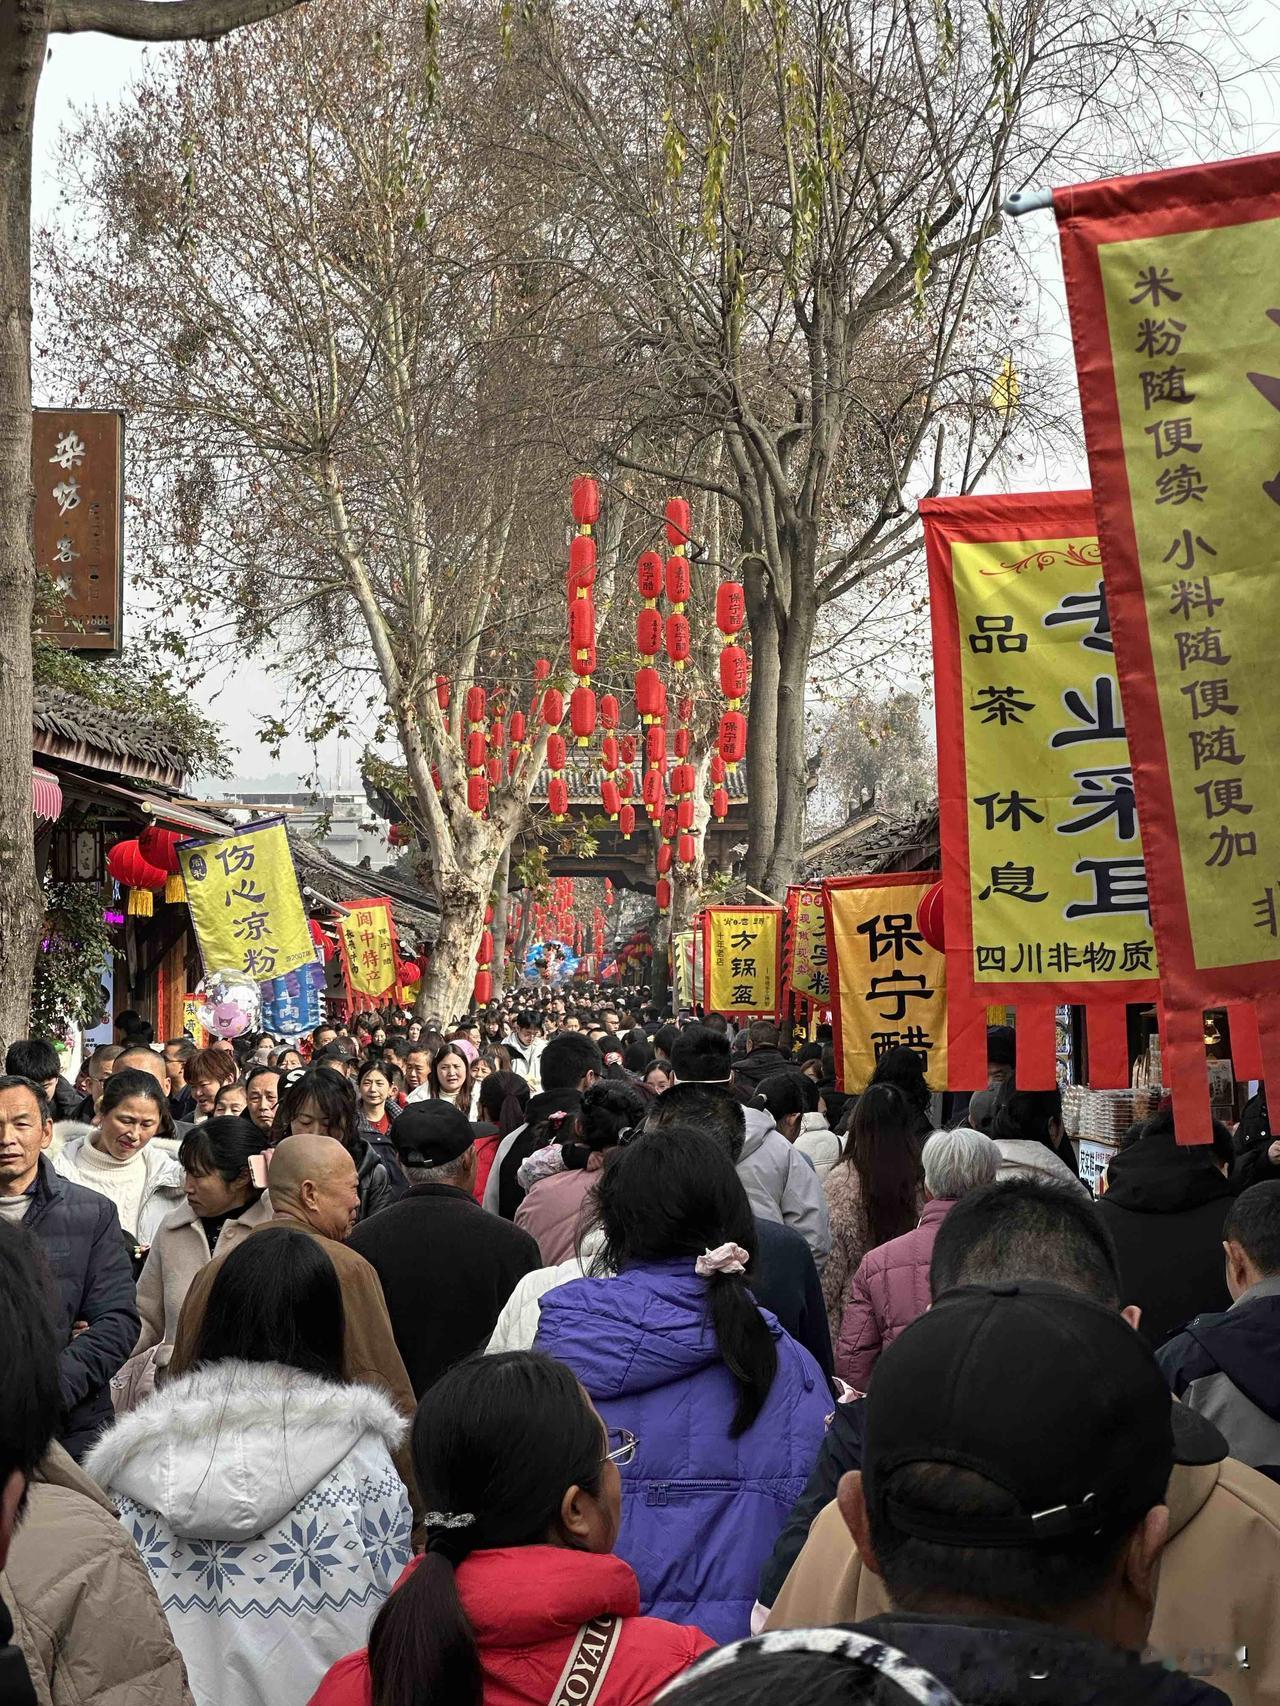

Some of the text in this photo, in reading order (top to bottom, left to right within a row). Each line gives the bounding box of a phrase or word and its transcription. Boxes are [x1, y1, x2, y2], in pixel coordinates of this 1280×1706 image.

[729, 594, 741, 624] 保宁醋
[724, 722, 737, 754] 保宁醋
[215, 844, 279, 976] 伤心凉粉
[356, 911, 380, 990] 阆中特产
[731, 930, 757, 1005] 方锅盔
[976, 940, 1159, 973] 四川非物质
[857, 914, 935, 1073] 保宁醋
